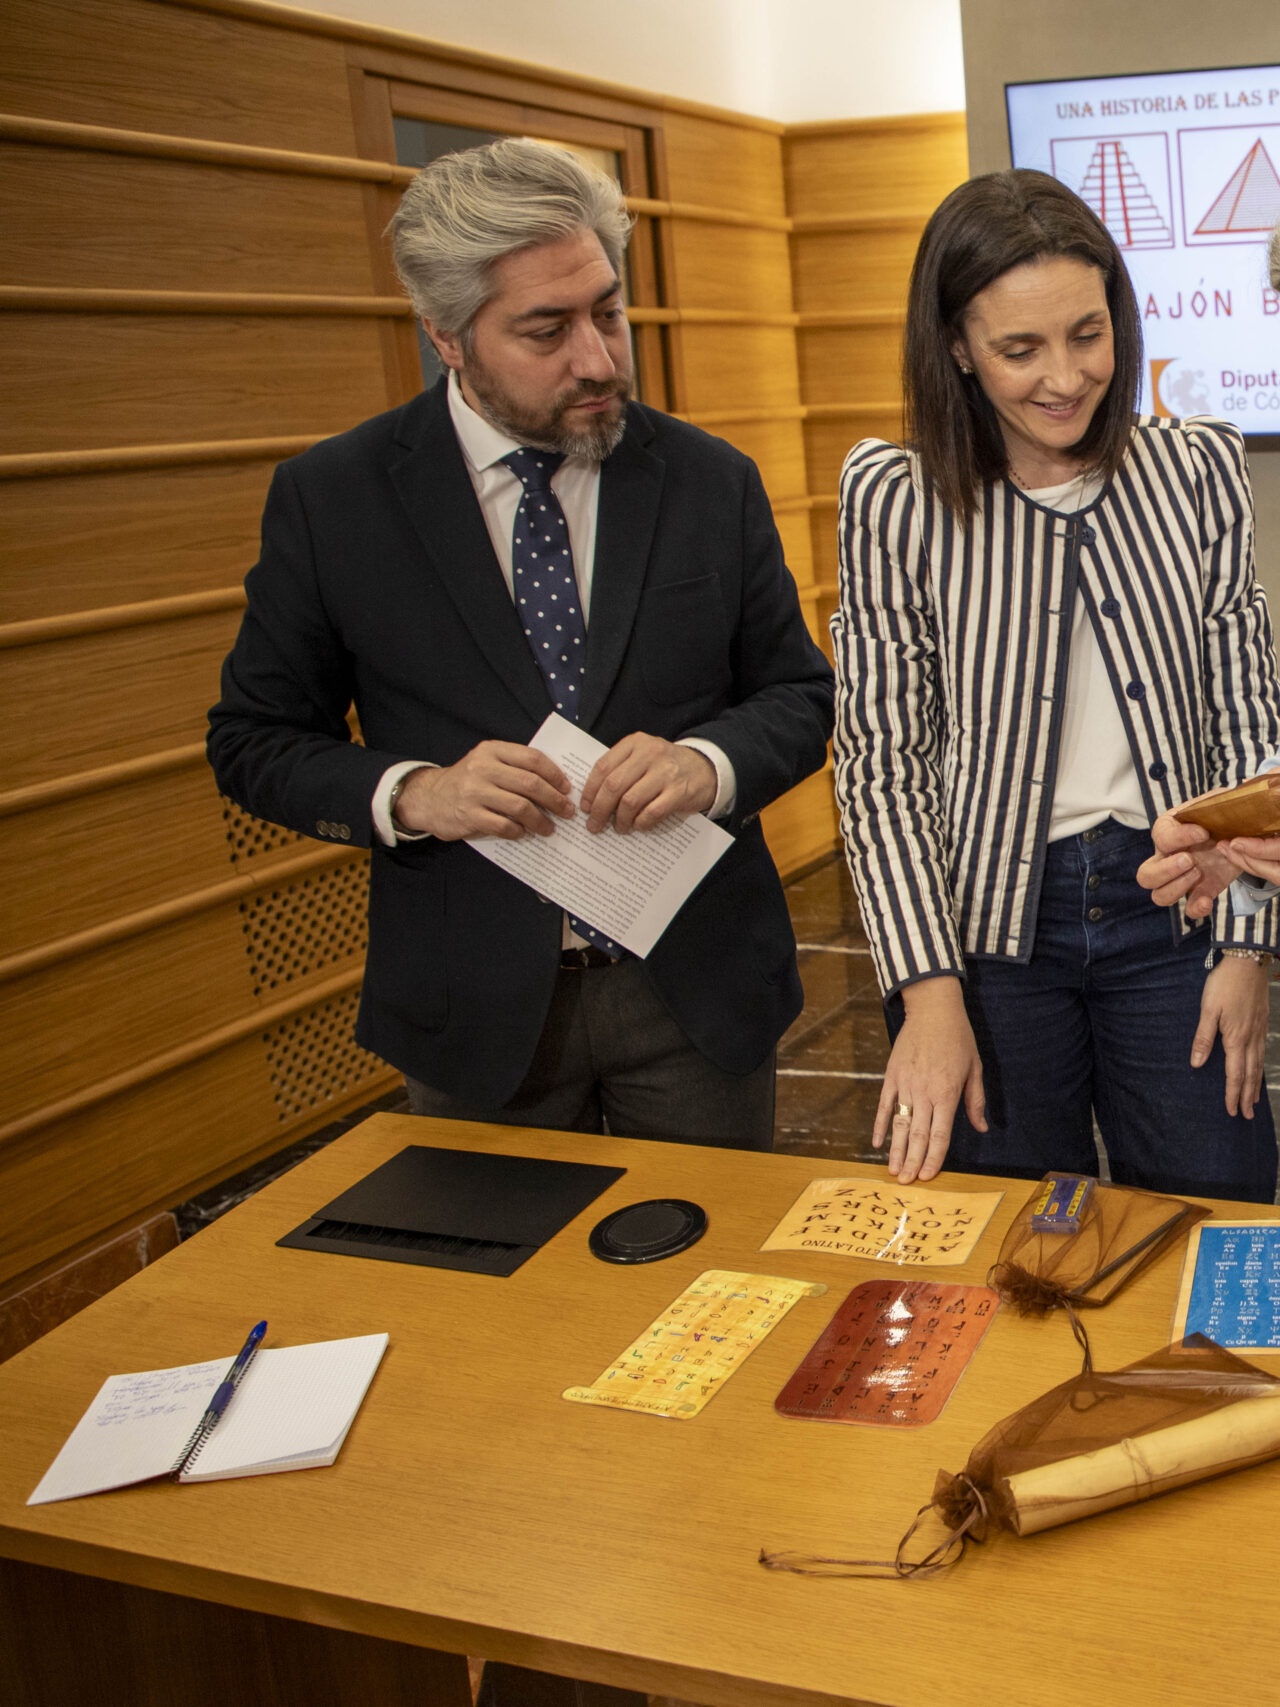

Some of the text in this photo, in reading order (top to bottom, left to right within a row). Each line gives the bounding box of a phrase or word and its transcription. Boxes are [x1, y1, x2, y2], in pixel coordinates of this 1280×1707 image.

[1056, 103, 1095, 119] UNA
[1100, 95, 1188, 117] HISTORIA
[1194, 93, 1219, 110] DE
[1225, 89, 1262, 108] LAS
[1144, 277, 1233, 320] AJÓN
[1223, 392, 1247, 411] de
[801, 1240, 931, 1262] ALFABETO LATINO
